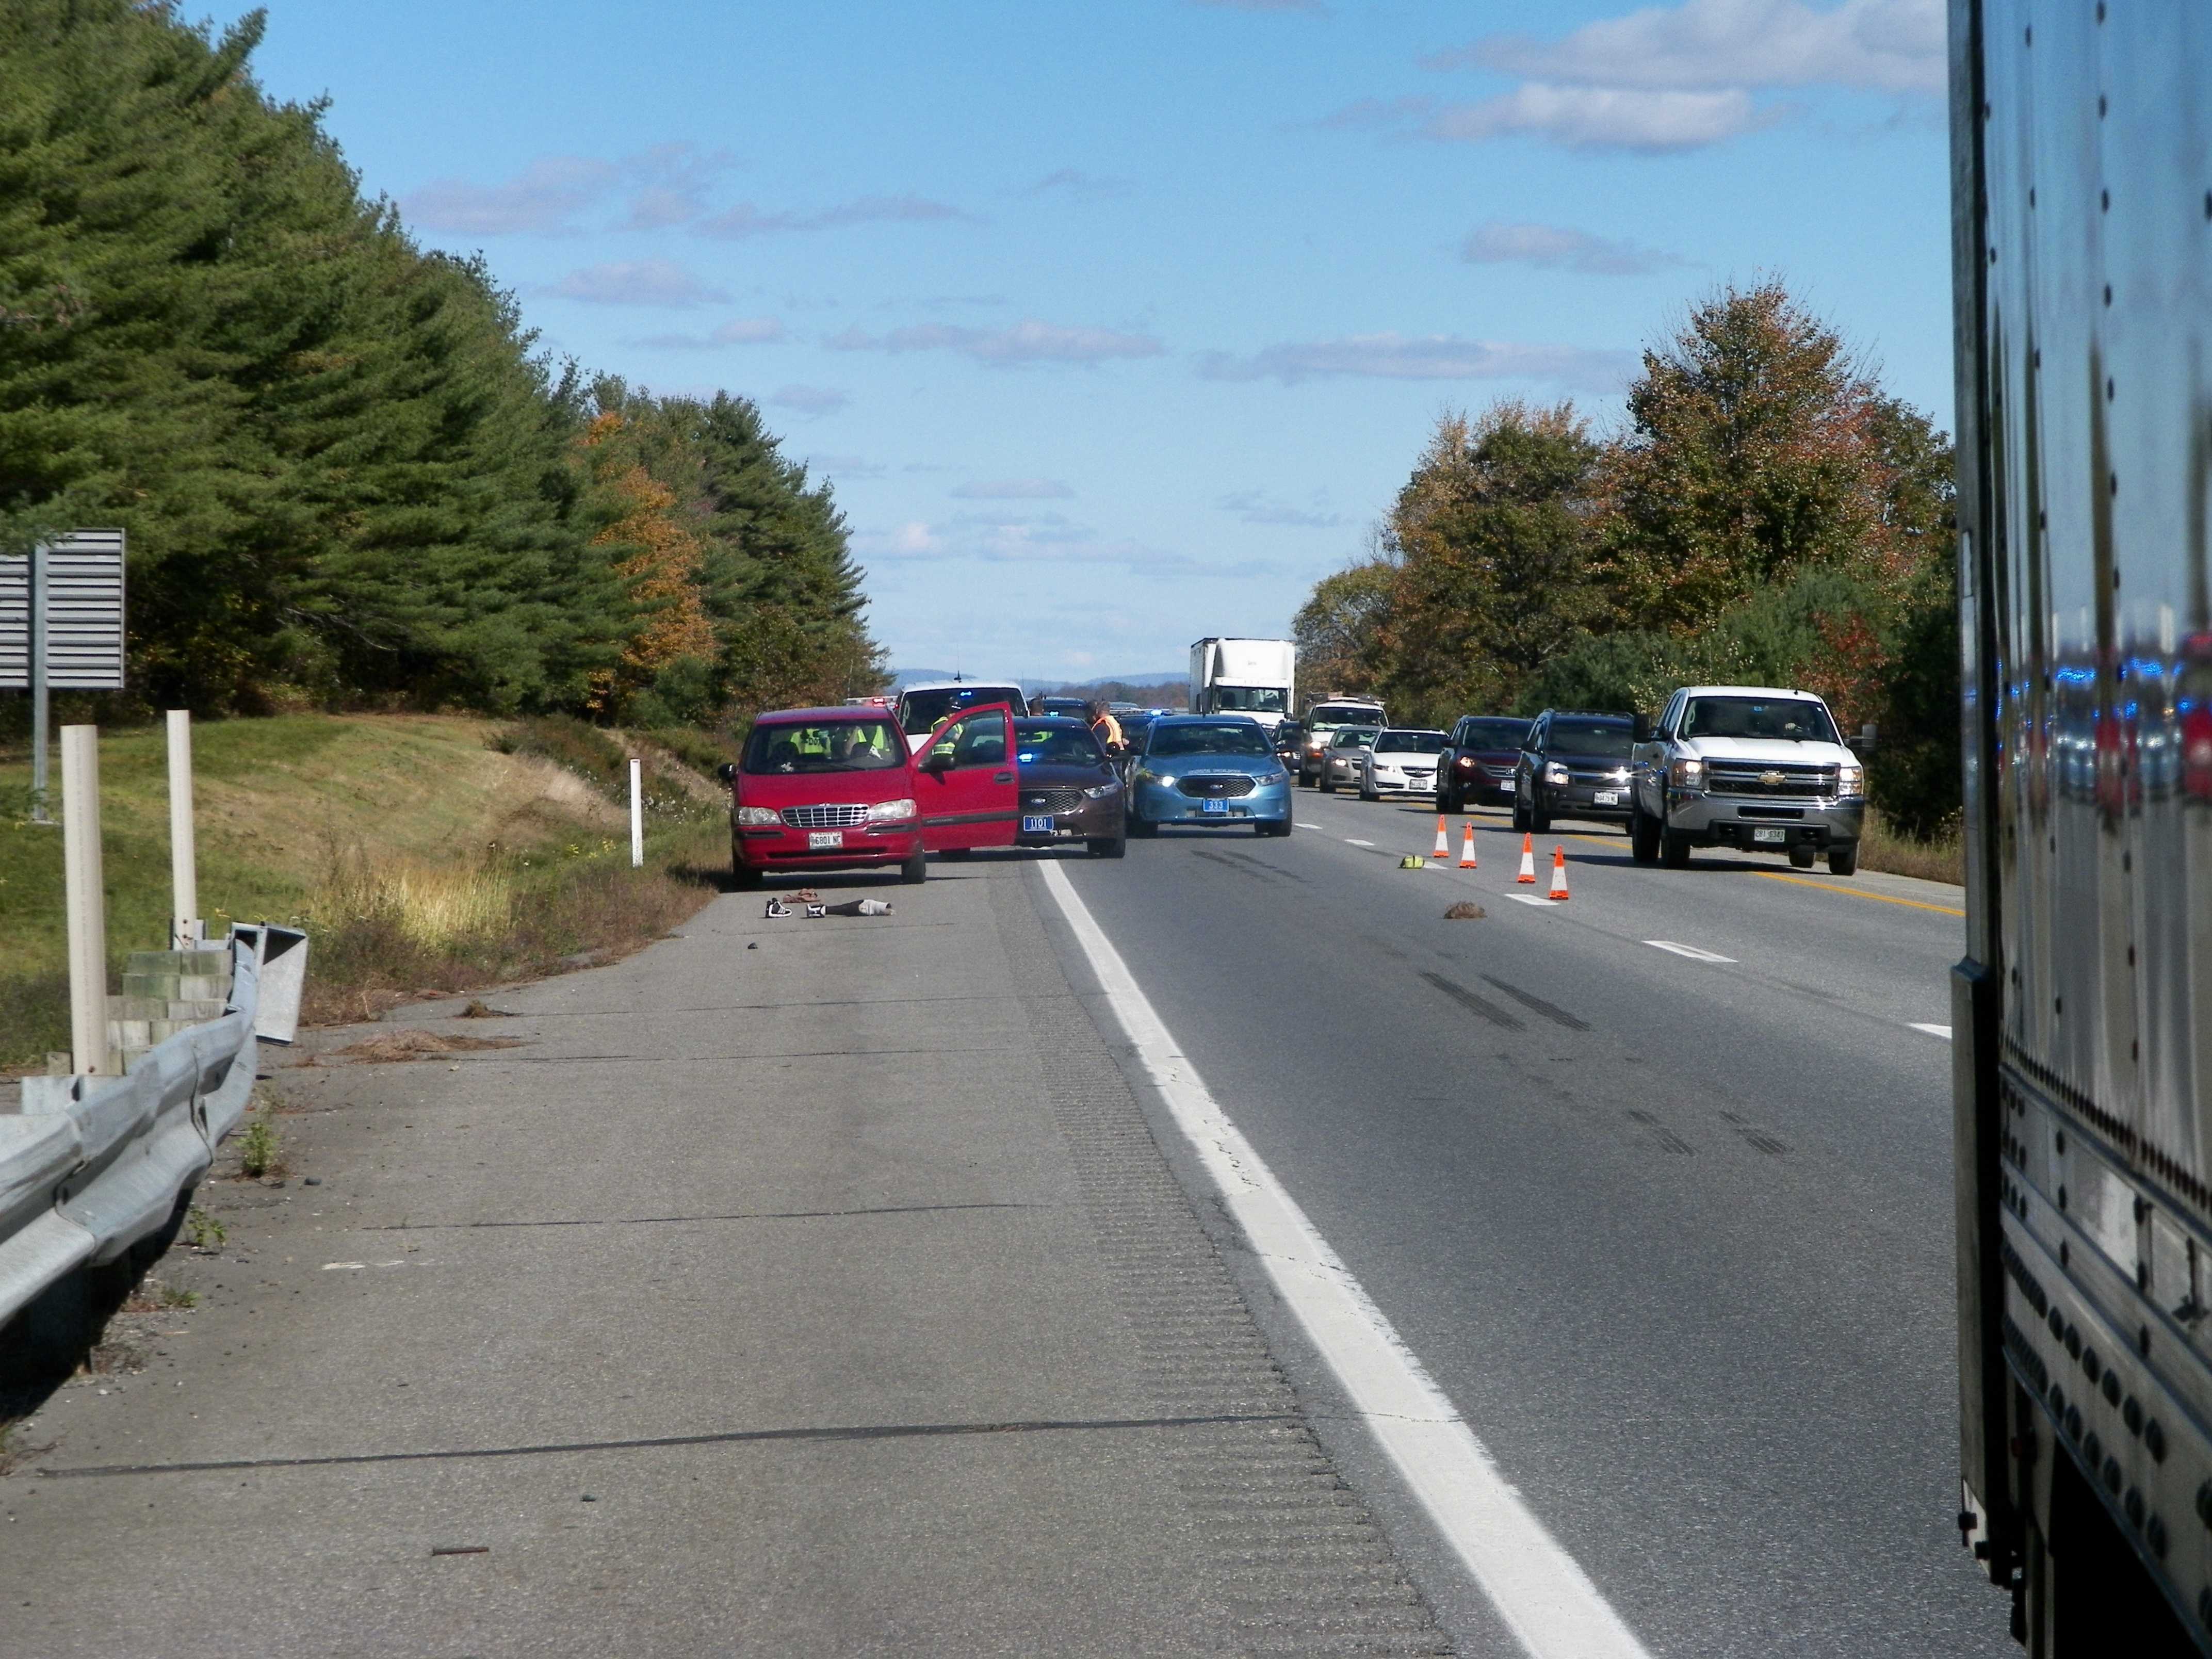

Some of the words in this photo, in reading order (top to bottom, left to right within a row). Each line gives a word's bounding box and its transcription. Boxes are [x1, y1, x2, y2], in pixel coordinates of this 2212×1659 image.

[1209, 801, 1223, 809] 333
[1031, 819, 1046, 827] 1101
[815, 836, 830, 844] 6801
[833, 835, 840, 843] NC
